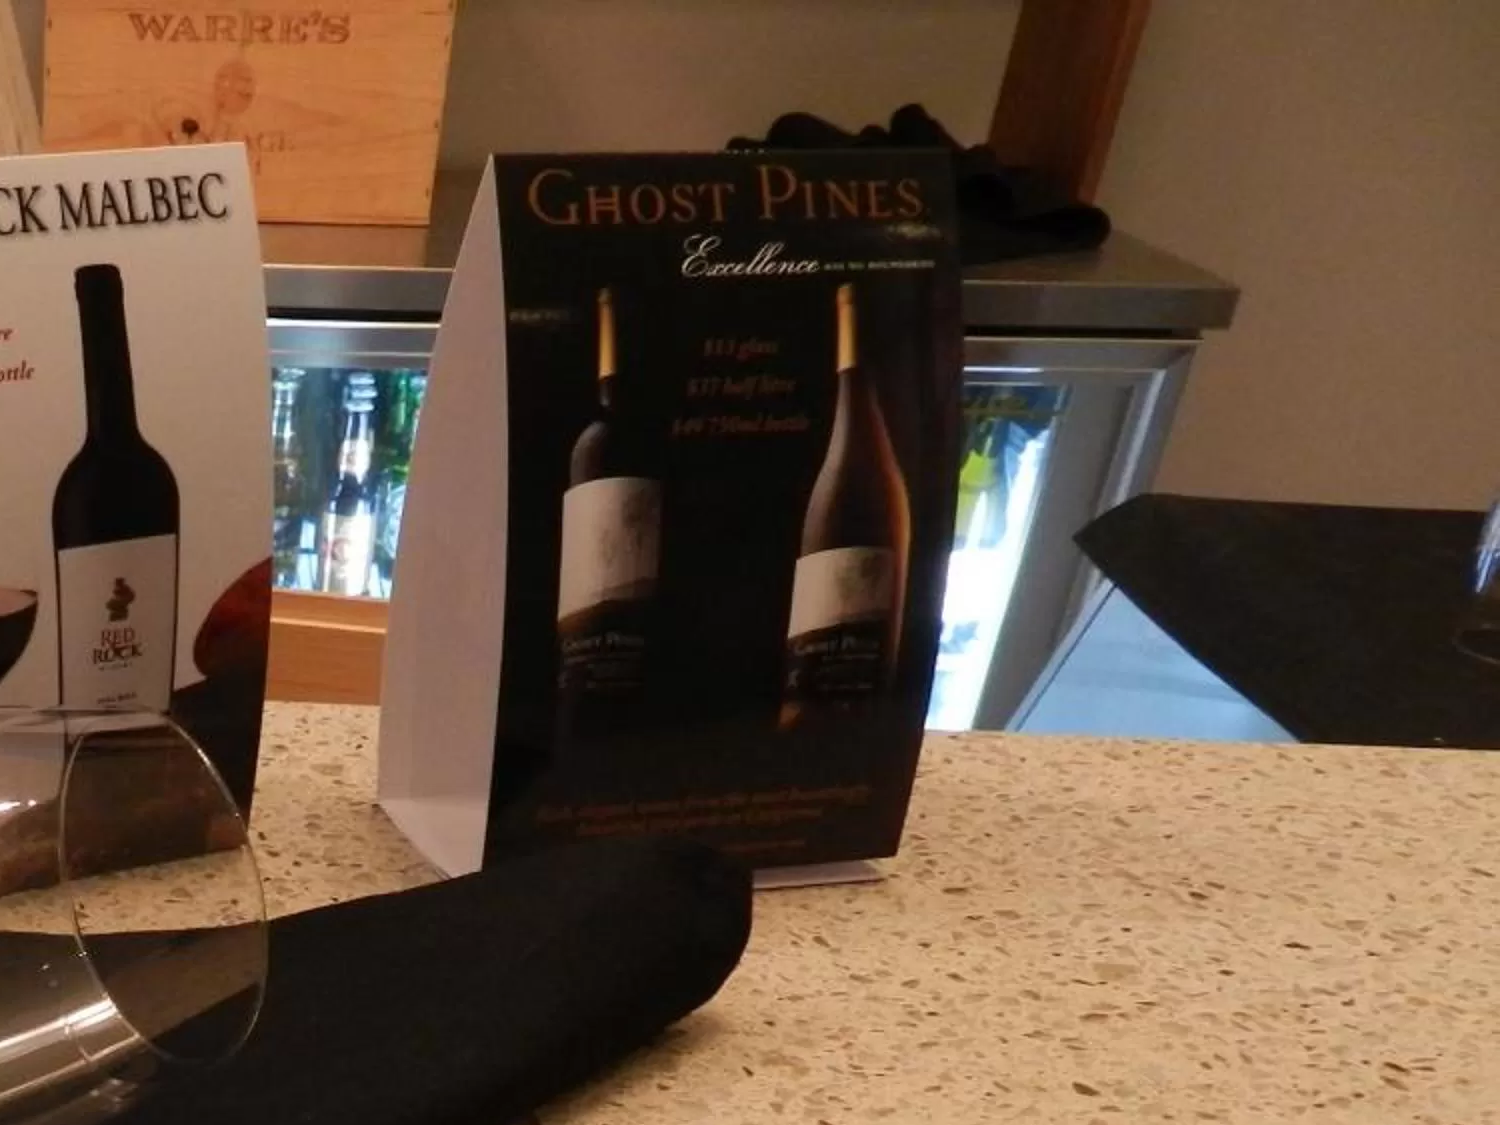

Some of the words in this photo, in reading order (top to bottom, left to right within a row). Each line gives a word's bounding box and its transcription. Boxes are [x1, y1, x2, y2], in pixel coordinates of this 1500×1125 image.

[128, 10, 350, 44] WARRE'S
[57, 172, 229, 231] MALBEC
[528, 168, 736, 226] GHOST
[756, 164, 924, 221] PINES
[680, 234, 820, 278] Excellence
[100, 626, 136, 648] RED
